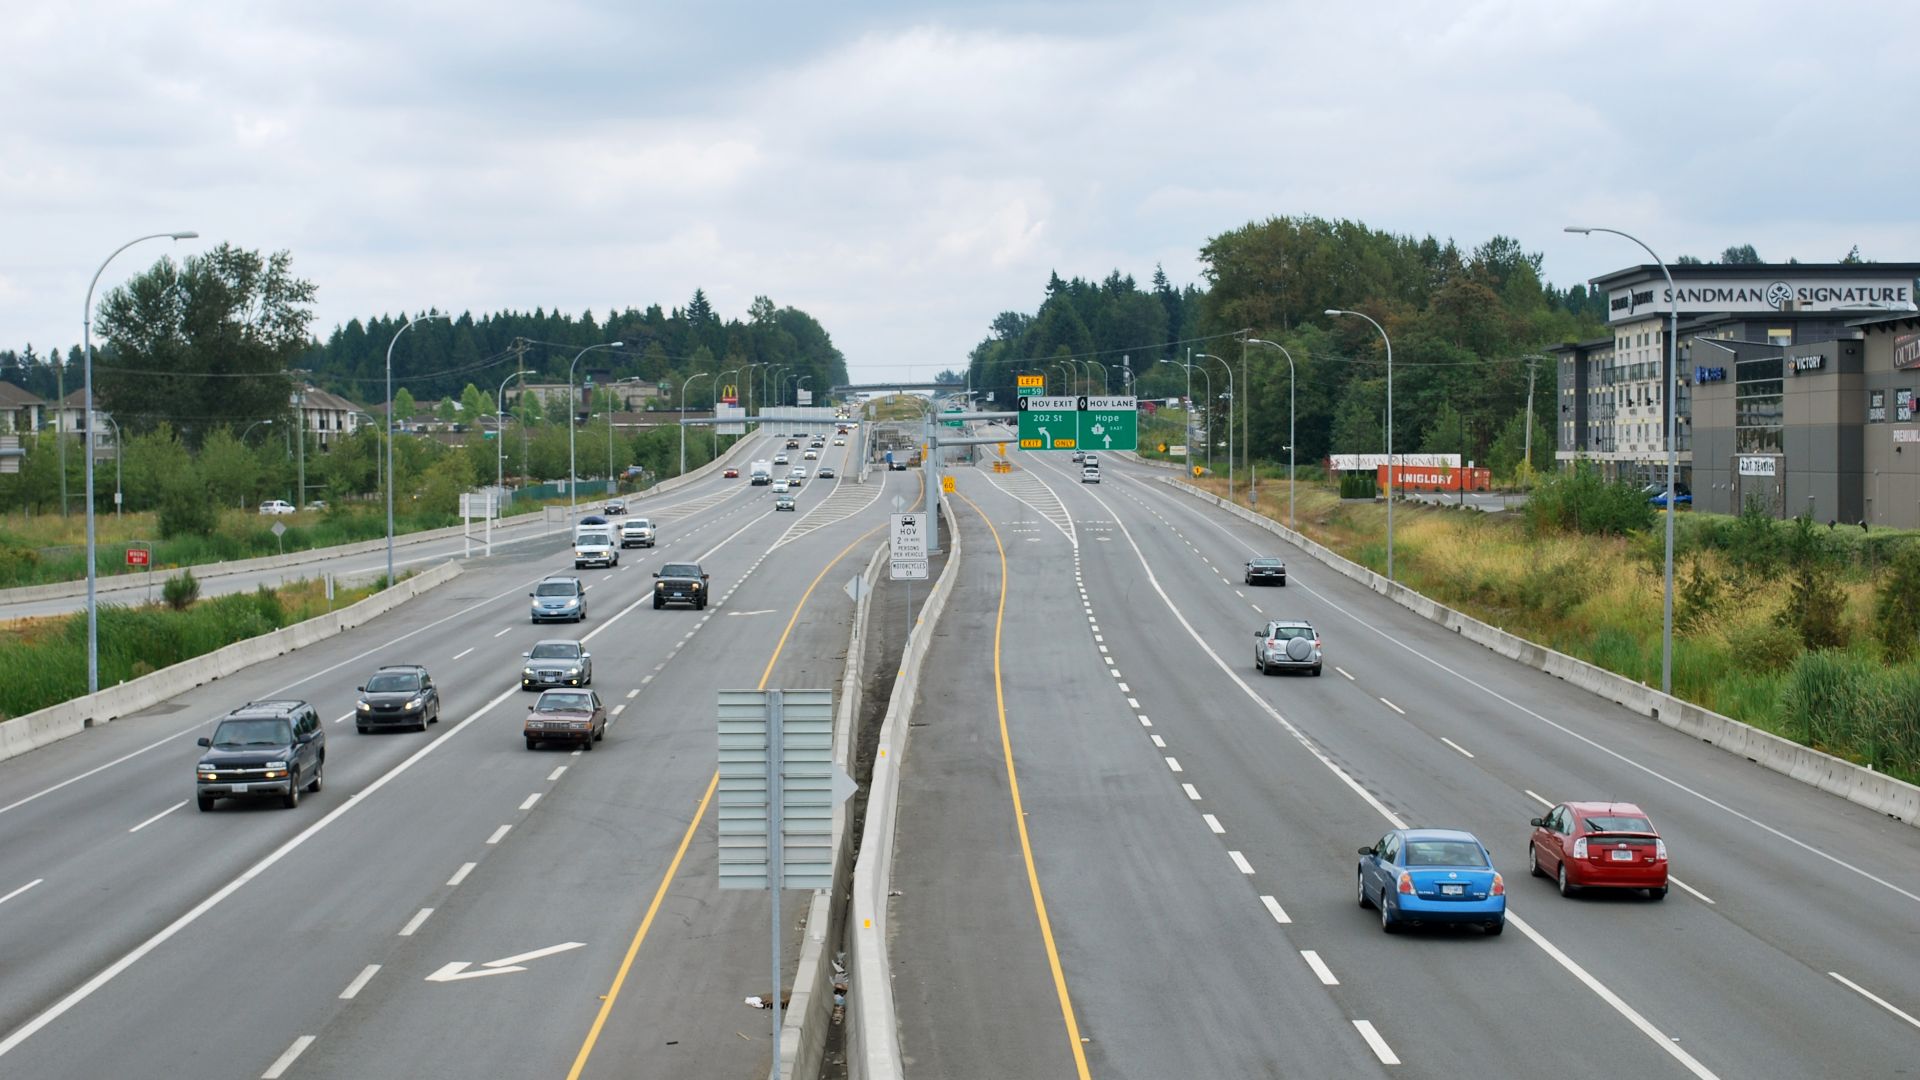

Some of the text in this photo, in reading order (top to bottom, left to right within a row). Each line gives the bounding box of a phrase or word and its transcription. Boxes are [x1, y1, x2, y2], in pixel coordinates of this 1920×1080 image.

[1664, 288, 1762, 303] SANDMAN
[1797, 287, 1908, 302] SIGNATURE
[1796, 355, 1822, 370] VICTORY
[1033, 414, 1062, 422] 202 St
[1095, 414, 1120, 424] Hope
[1398, 473, 1453, 485] UNIGLORY
